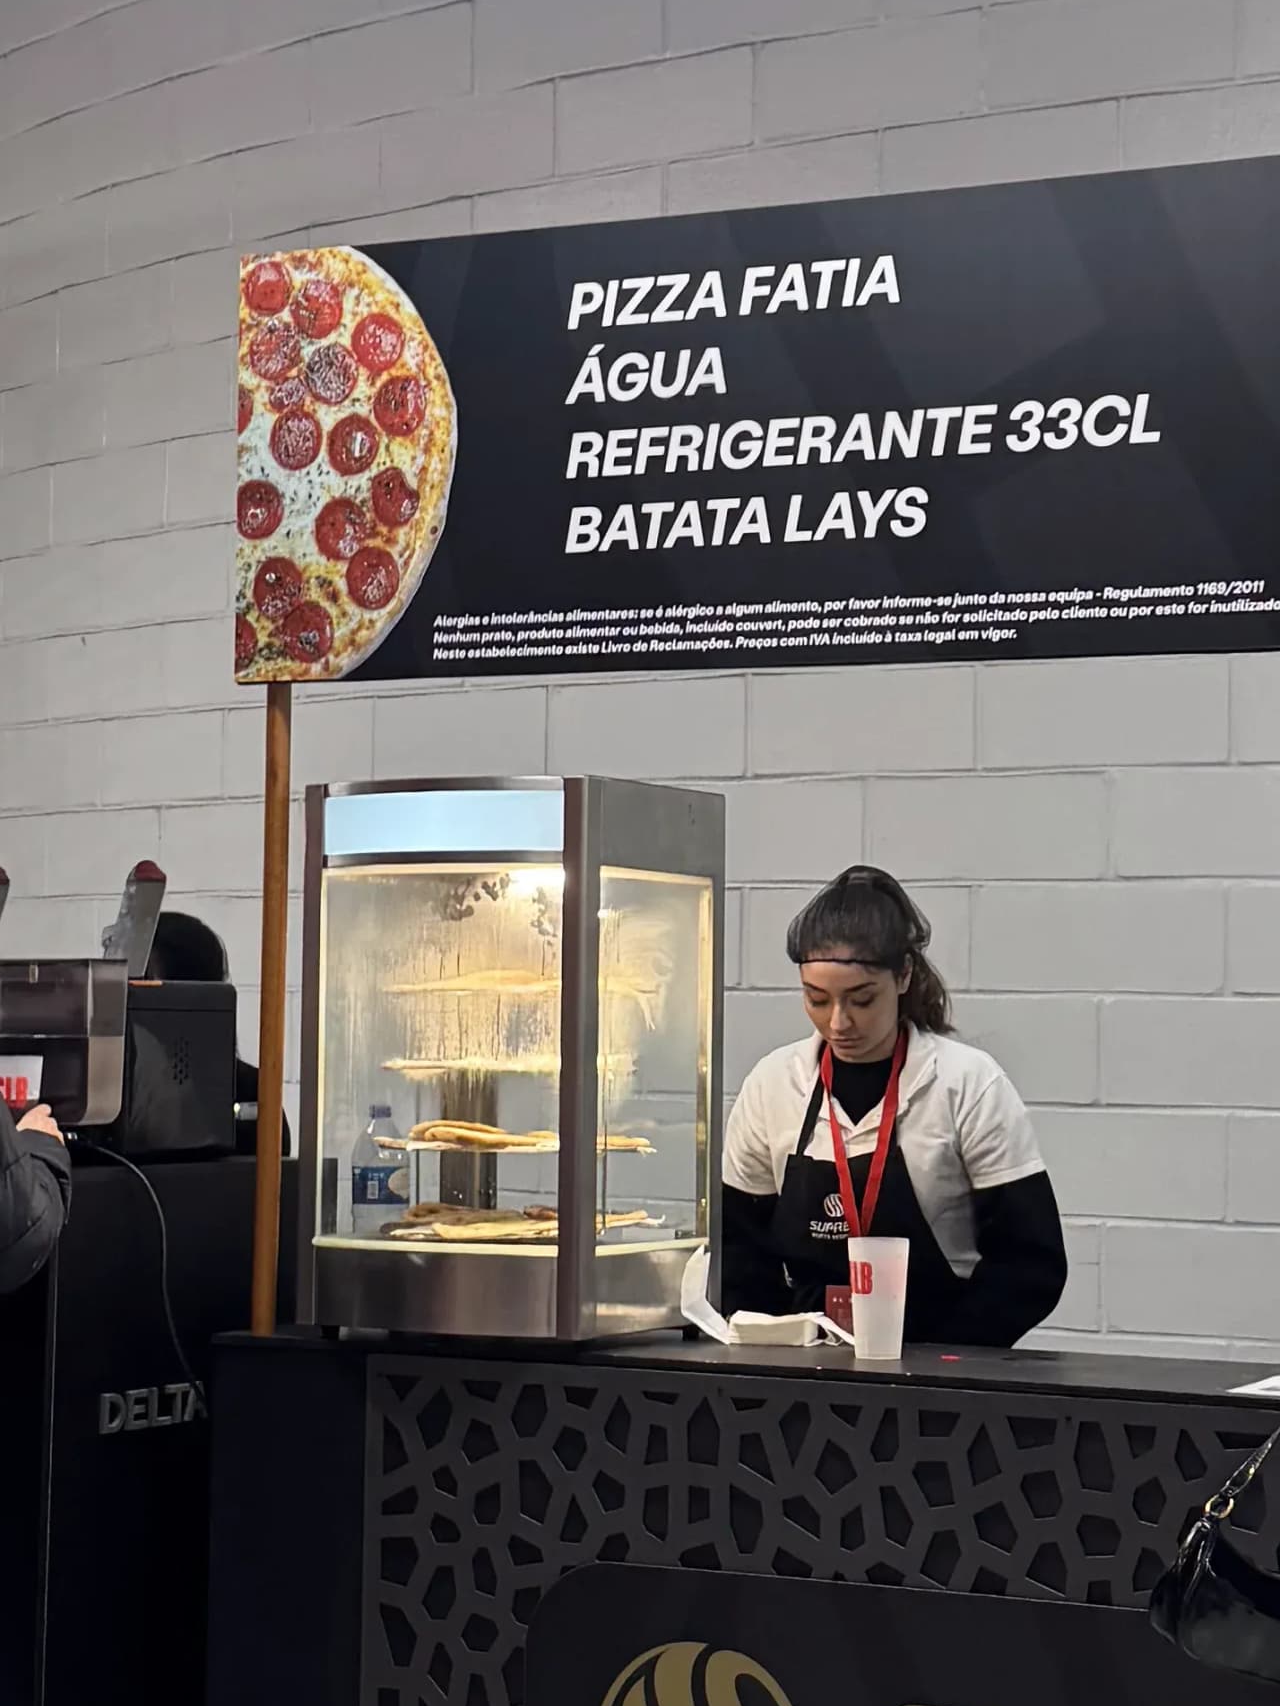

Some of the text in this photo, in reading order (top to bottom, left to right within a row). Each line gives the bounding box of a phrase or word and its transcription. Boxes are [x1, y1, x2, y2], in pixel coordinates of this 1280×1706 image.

[568, 254, 901, 329] PIZZA FATIA
[565, 344, 727, 405] ÁGUA
[565, 394, 1161, 479] REFRIGERANTE 33CL
[565, 486, 929, 554] BATATA LAYS
[433, 613, 480, 629] Alergias
[490, 610, 564, 624] intolerâncias
[664, 604, 714, 620] alérgico
[724, 602, 764, 617] algum
[764, 600, 822, 614] alimento,
[823, 601, 847, 614] por
[847, 598, 881, 609] favor
[882, 596, 953, 608] informe-se
[952, 593, 987, 609] junto
[988, 592, 1007, 604] da
[1007, 593, 1047, 603] nossa
[1047, 588, 1093, 604] equipa
[1103, 585, 1194, 602] Regulamento
[1196, 581, 1265, 597] 1169/2011
[433, 630, 480, 643] Nenhum
[481, 630, 516, 645] prato,
[516, 627, 564, 643] produto
[564, 626, 621, 638] alimentar
[622, 627, 638, 636] ou
[639, 622, 685, 637] bebida,
[685, 620, 735, 633] incluído
[821, 619, 842, 628] ser
[843, 614, 897, 627] cobrado
[915, 612, 940, 624] não
[941, 612, 961, 623] for
[962, 609, 1028, 623] solicitado
[1028, 607, 1060, 623] pelo
[1061, 606, 1109, 619] cliente
[1109, 608, 1128, 617] ou
[1128, 607, 1154, 620] por
[1187, 602, 1208, 614] for
[433, 647, 466, 659] Neste
[466, 644, 564, 658] estabelecimento
[564, 642, 600, 655] existe
[600, 641, 631, 653] Livro
[632, 640, 648, 652] de
[735, 637, 778, 651] Preços
[779, 638, 808, 647] com
[809, 634, 831, 646] IVA
[831, 632, 883, 645] incluído
[894, 632, 922, 643] taxa
[923, 629, 956, 645] legal
[957, 632, 978, 640] em
[980, 627, 1017, 643] vigor.
[100, 1381, 207, 1434] DELTA
